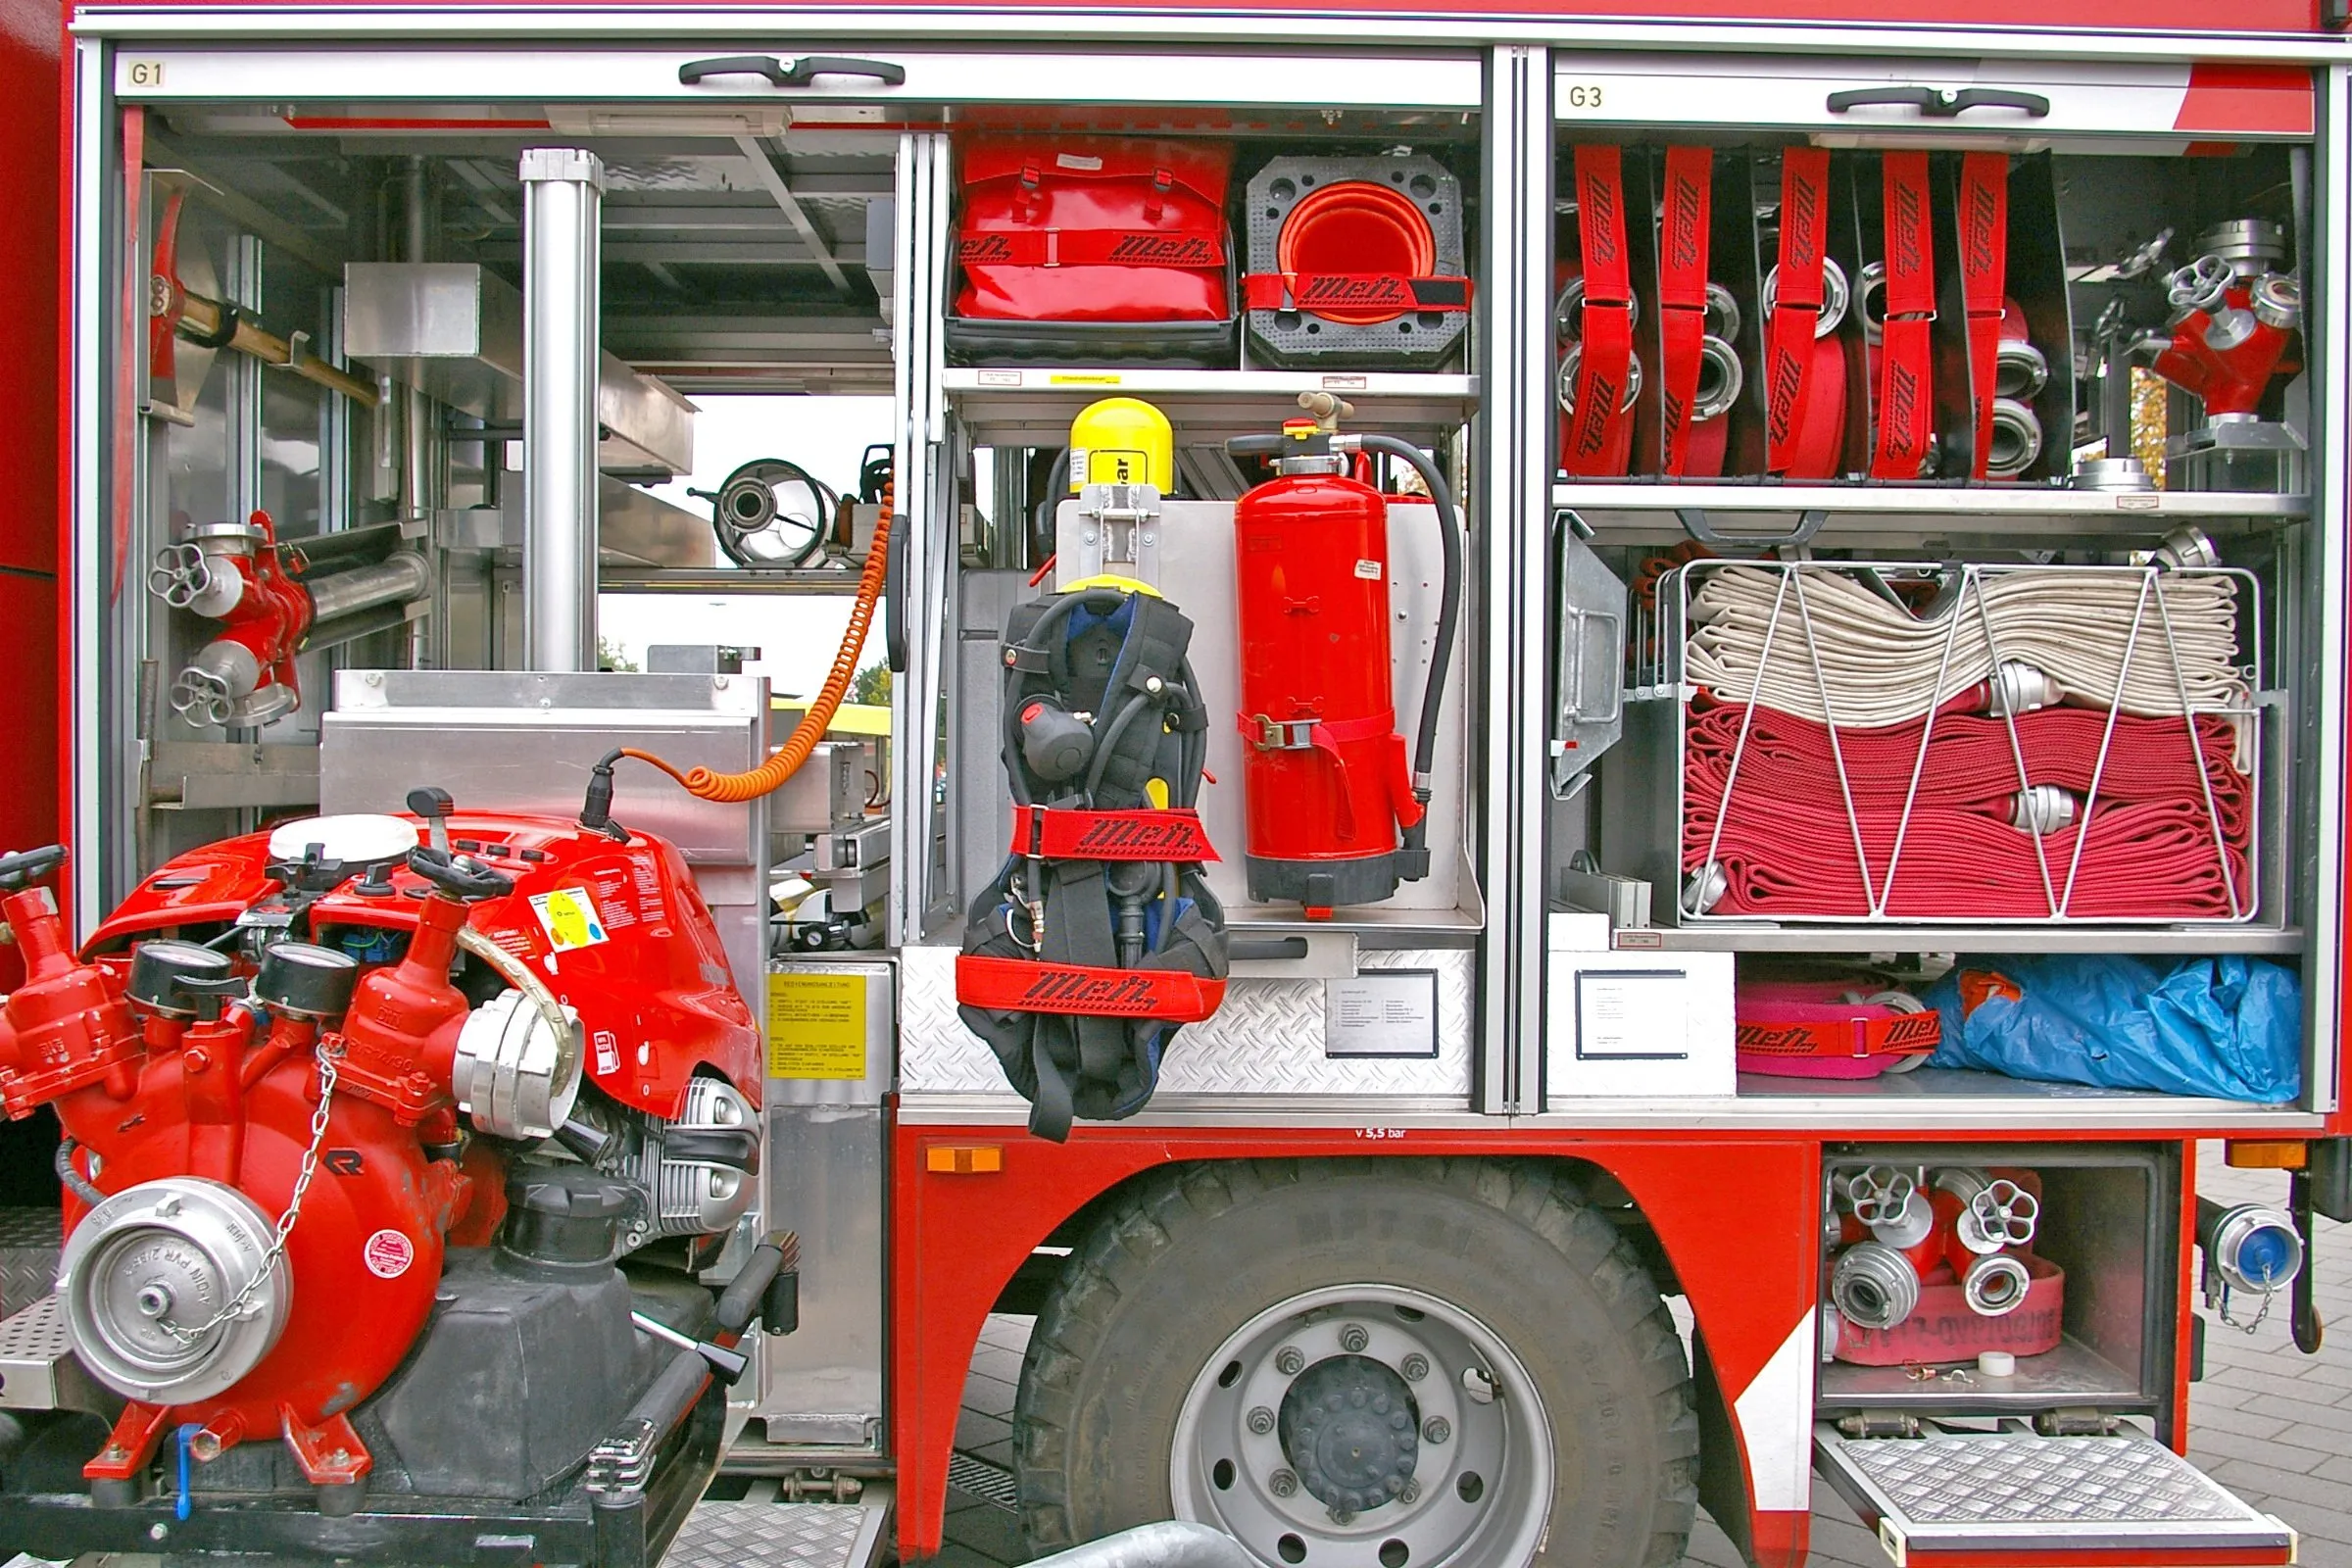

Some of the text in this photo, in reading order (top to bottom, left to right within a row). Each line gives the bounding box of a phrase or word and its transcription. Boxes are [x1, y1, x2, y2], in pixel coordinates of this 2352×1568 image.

[132, 63, 161, 85] G1
[1570, 85, 1601, 108] G3
[1354, 1128, 1406, 1140] v 5,5 bar
